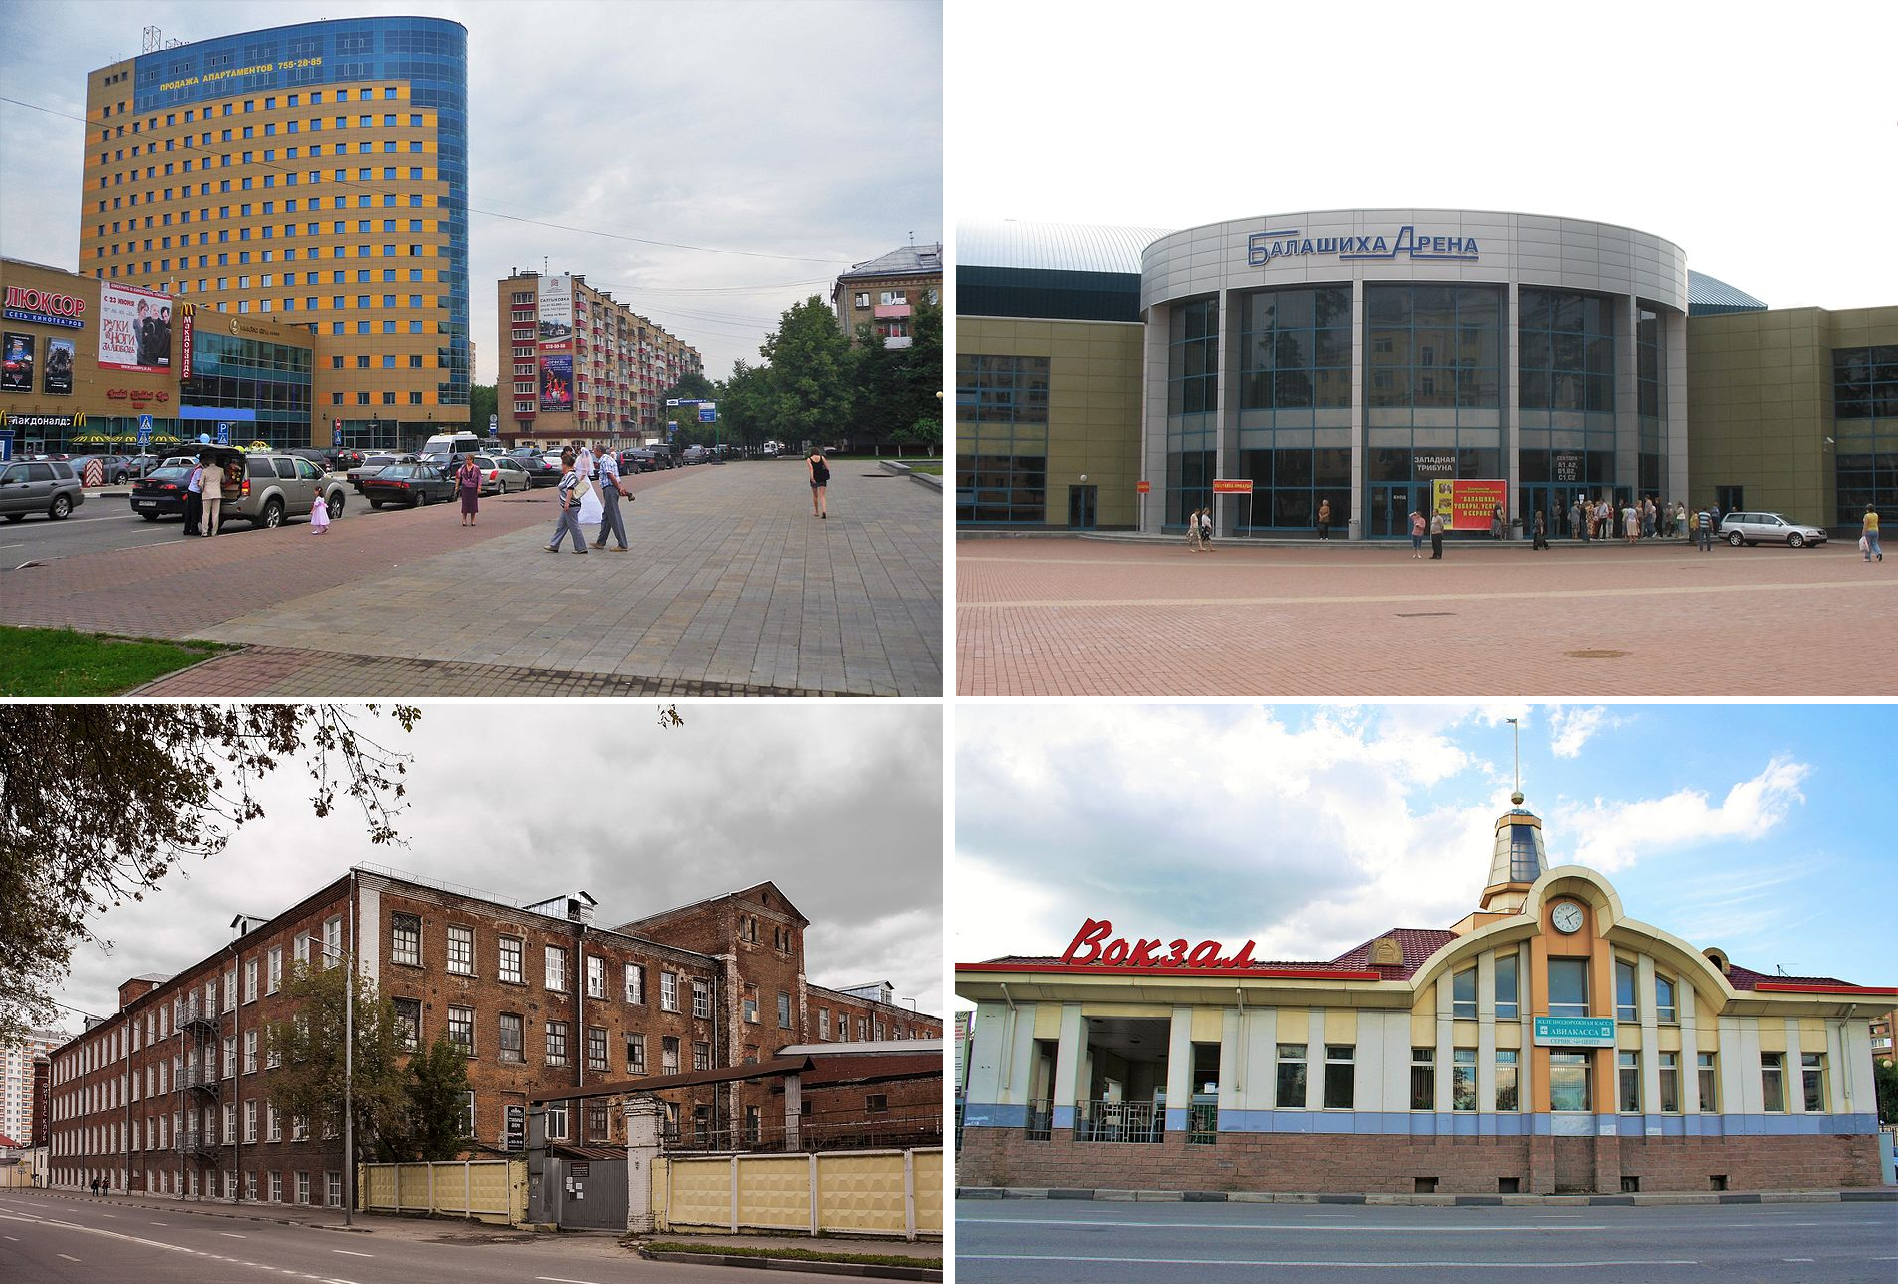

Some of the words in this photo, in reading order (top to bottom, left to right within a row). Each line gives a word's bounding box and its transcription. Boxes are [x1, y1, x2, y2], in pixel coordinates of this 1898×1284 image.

[159, 77, 200, 92] ПРОДАЖА
[202, 64, 274, 83] АПАРТАМЕНТОВ
[1248, 229, 1388, 267] БАЛАШИХА
[6, 285, 86, 317] ЛЮКСОР
[8, 311, 28, 319] СЕТЬ
[32, 315, 82, 327] КИНОТЕАТРОВ
[103, 318, 129, 333] РУКИ
[111, 331, 135, 346] НОГИ
[1414, 456, 1456, 464] ЗАПАДНАЯ
[1059, 917, 1257, 969] Вокзал
[1550, 1028, 1599, 1036] АВИАКАССА
